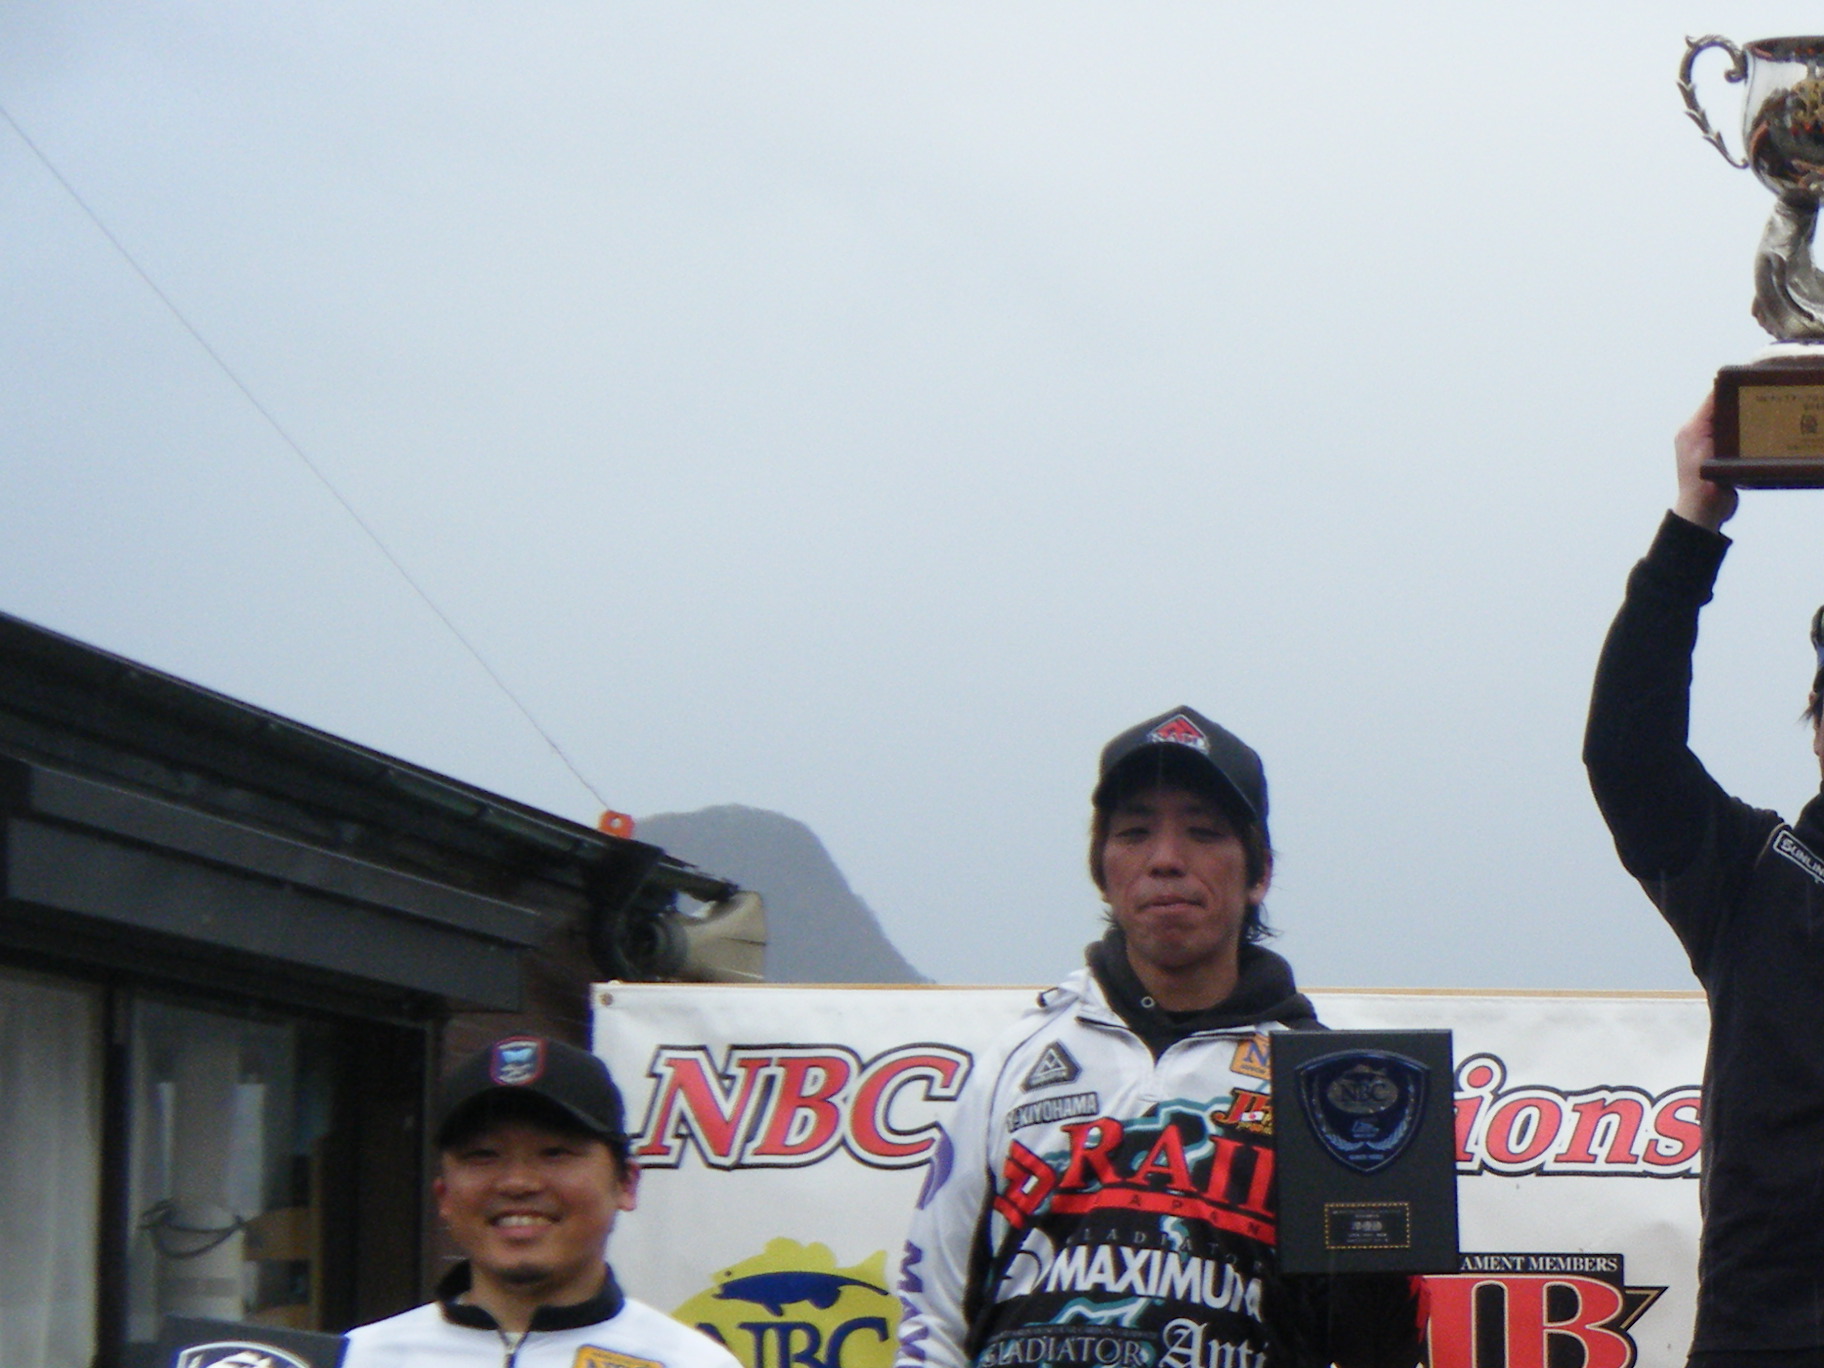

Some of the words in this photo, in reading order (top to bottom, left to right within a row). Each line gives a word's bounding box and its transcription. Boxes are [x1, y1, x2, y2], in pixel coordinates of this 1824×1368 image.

[637, 1046, 970, 1167] NBC
[1454, 1058, 1701, 1172] ions
[1045, 1246, 1264, 1324] MAXIMUM
[1461, 1256, 1524, 1272] AMENT
[1528, 1257, 1618, 1272] MEMBERS
